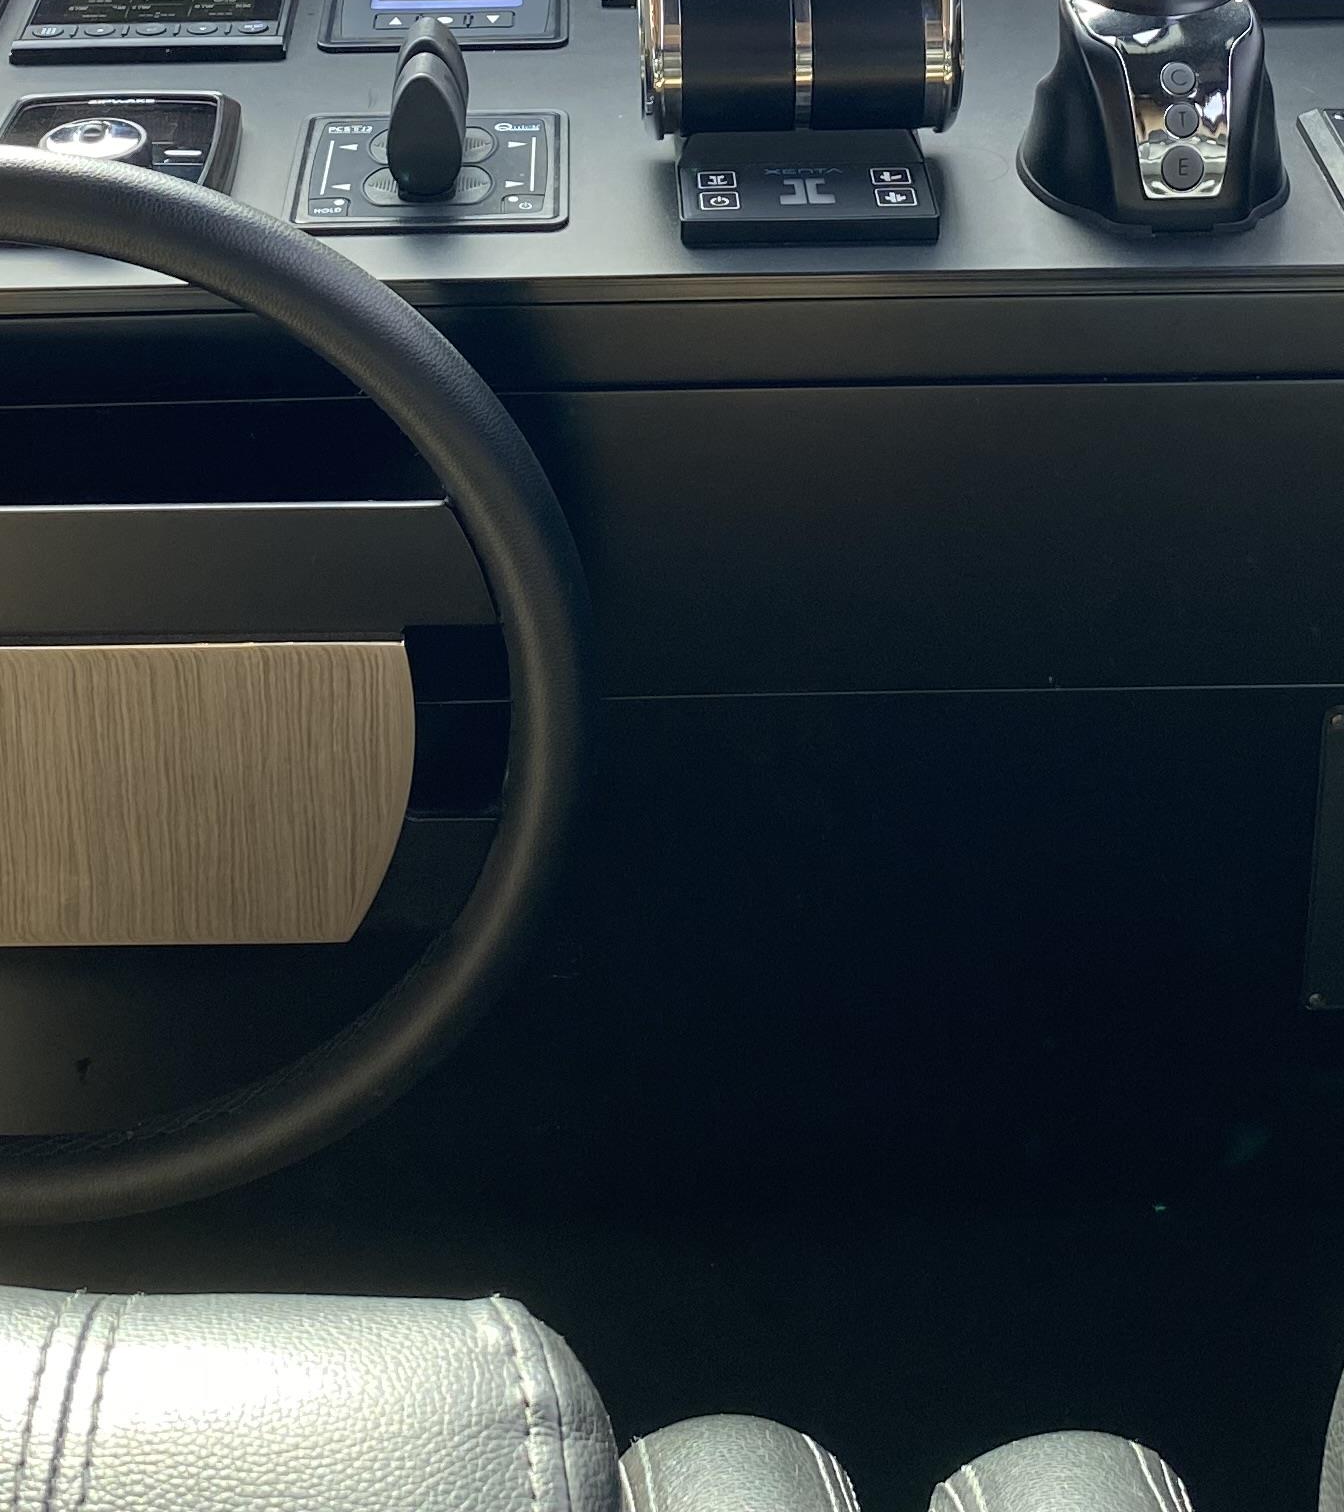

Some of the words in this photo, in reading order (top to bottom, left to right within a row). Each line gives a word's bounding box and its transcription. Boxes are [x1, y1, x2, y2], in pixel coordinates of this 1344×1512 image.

[1170, 68, 1188, 86] C
[494, 122, 541, 132] Quick
[1177, 110, 1187, 129] T
[1178, 157, 1189, 176] E
[313, 206, 342, 215] HOLD
